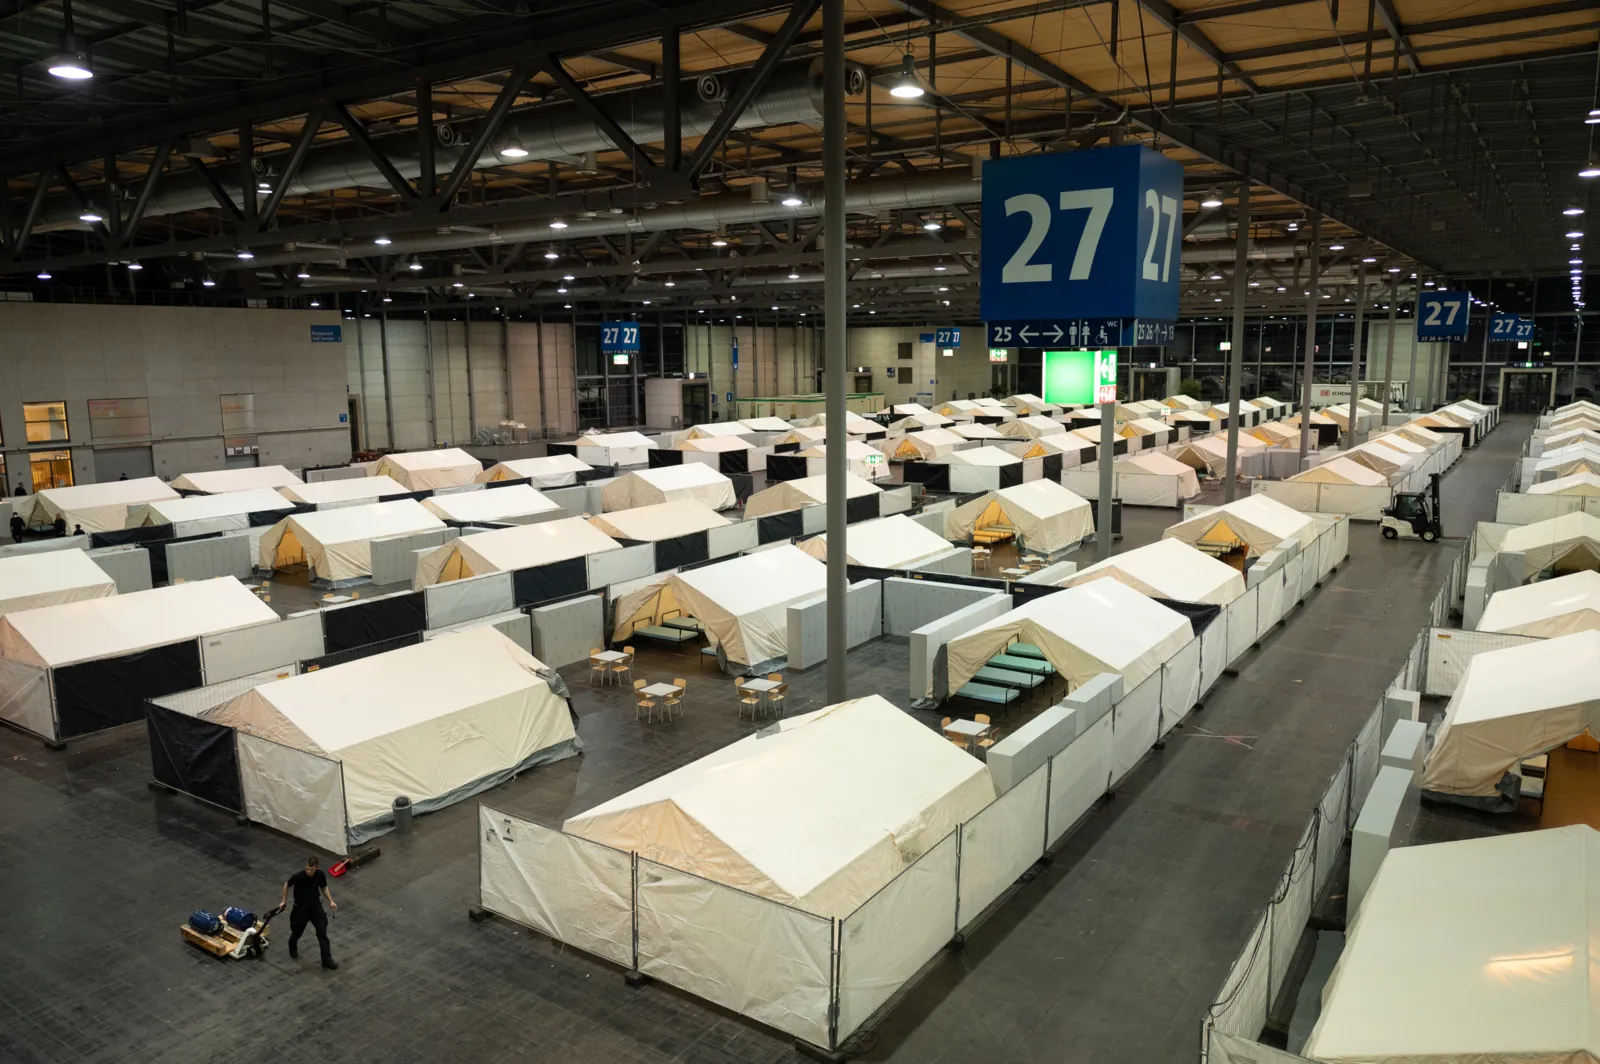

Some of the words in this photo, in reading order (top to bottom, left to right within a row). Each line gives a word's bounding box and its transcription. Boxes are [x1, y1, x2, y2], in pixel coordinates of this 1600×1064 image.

[1002, 187, 1114, 283] 27
[1142, 188, 1177, 283] 27
[1424, 301, 1461, 326] 27
[994, 326, 1012, 343] 25
[1137, 324, 1145, 340] 25
[1146, 324, 1153, 341] 26
[1493, 319, 1515, 334] 27
[1516, 325, 1532, 336] 27
[603, 327, 619, 344] 27
[623, 327, 638, 344] 27
[938, 332, 951, 343] 27
[953, 332, 960, 343] 27
